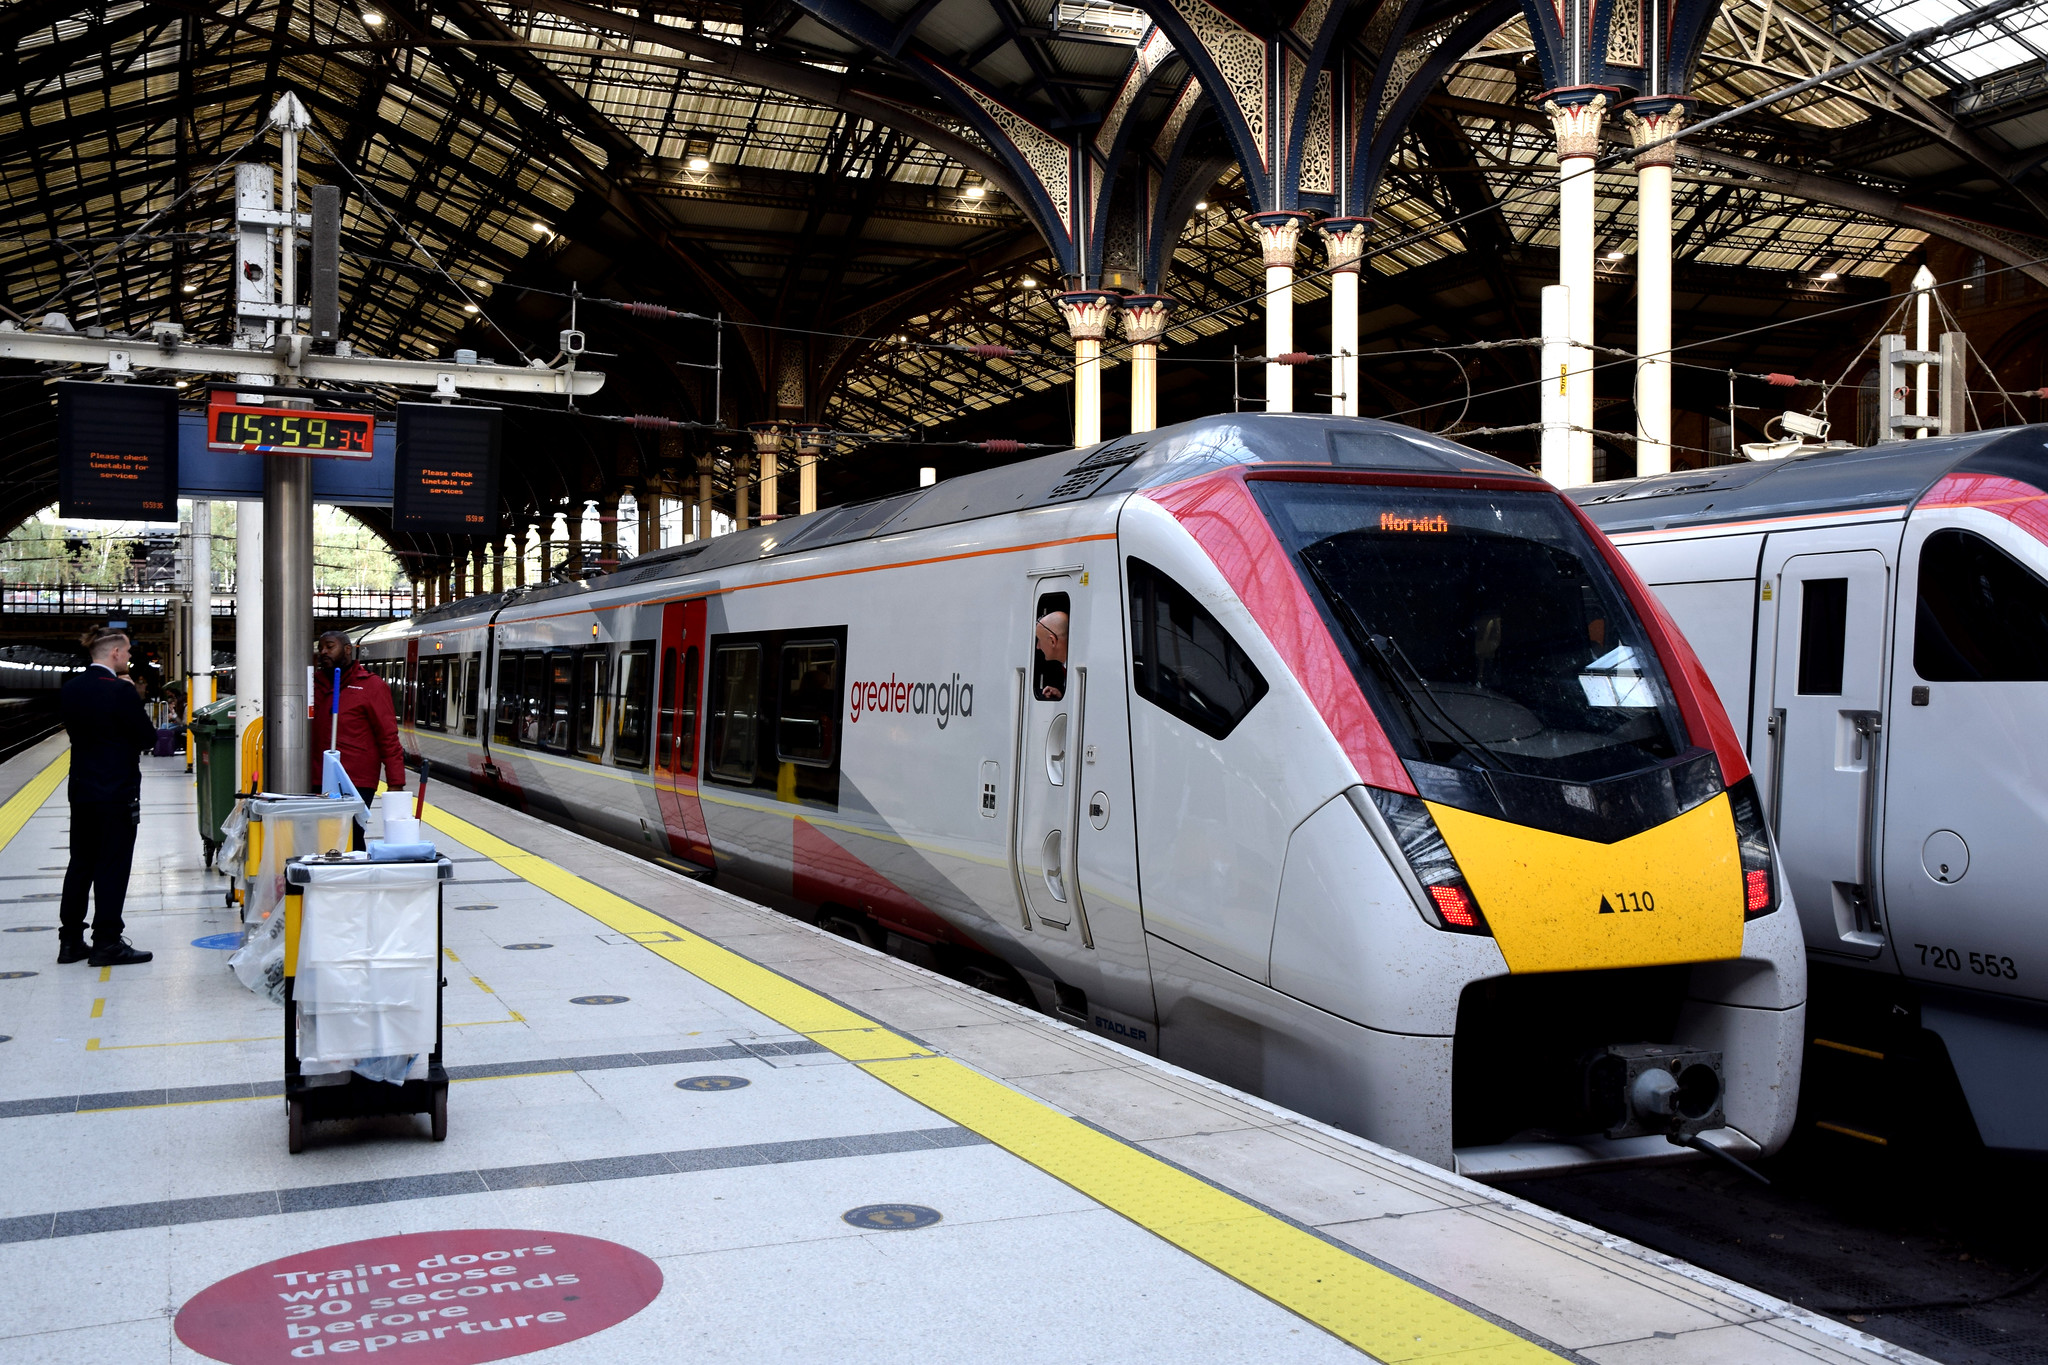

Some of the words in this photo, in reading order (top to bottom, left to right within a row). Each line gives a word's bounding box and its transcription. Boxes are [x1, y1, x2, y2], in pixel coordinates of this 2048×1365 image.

[231, 414, 327, 448] 15:59
[90, 452, 120, 460] Please
[90, 461, 132, 470] timetable
[421, 478, 458, 486] timetable
[1380, 512, 1448, 532] Norwich
[1615, 890, 1655, 913] 110
[1914, 943, 1961, 971] 720
[1969, 951, 2018, 980] 553
[1095, 1015, 1147, 1042] STADLER
[273, 1264, 401, 1286] Train
[417, 1245, 556, 1269] doors
[278, 1279, 369, 1302] will
[387, 1265, 518, 1289] close
[283, 1299, 353, 1320] 30
[369, 1273, 580, 1309] seconds
[287, 1305, 469, 1339] before
[290, 1311, 567, 1358] departure
